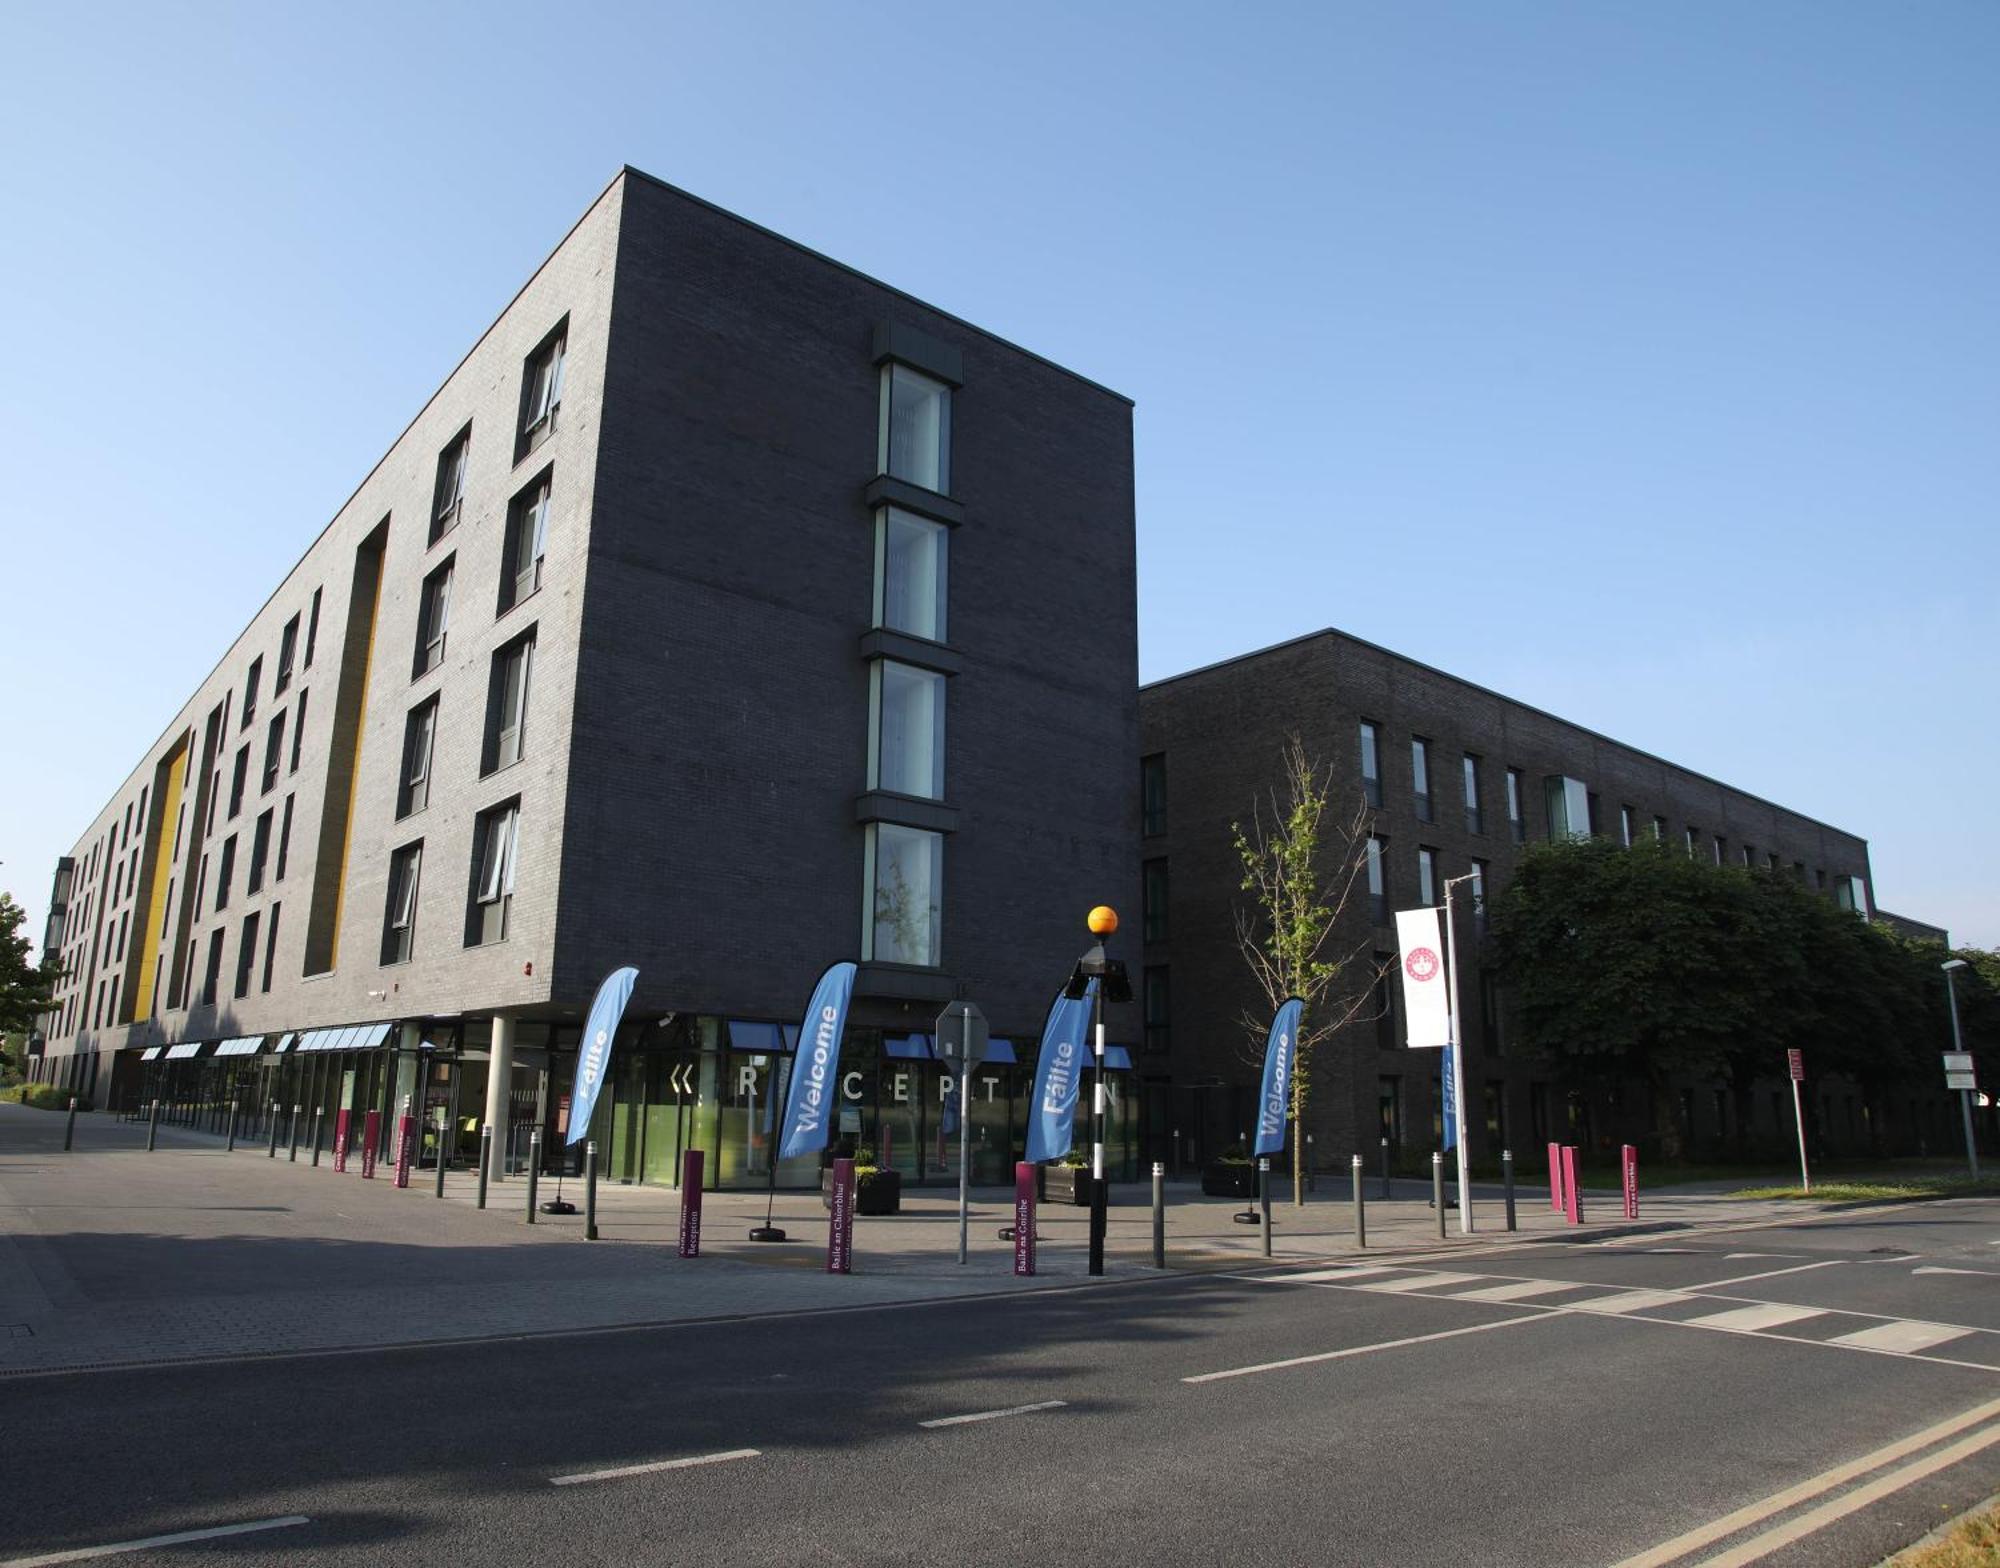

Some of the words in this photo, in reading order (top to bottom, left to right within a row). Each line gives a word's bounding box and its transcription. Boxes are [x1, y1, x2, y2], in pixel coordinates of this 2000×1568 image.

[797, 1005, 837, 1132] Welcome
[1043, 1041, 1073, 1114] Fáilte
[1260, 1033, 1288, 1135] Welcome
[688, 1211, 699, 1255] Reception
[835, 1233, 841, 1244] an
[1020, 1236, 1027, 1248] na
[832, 1246, 841, 1270] Baile
[1018, 1248, 1027, 1272] Baile
